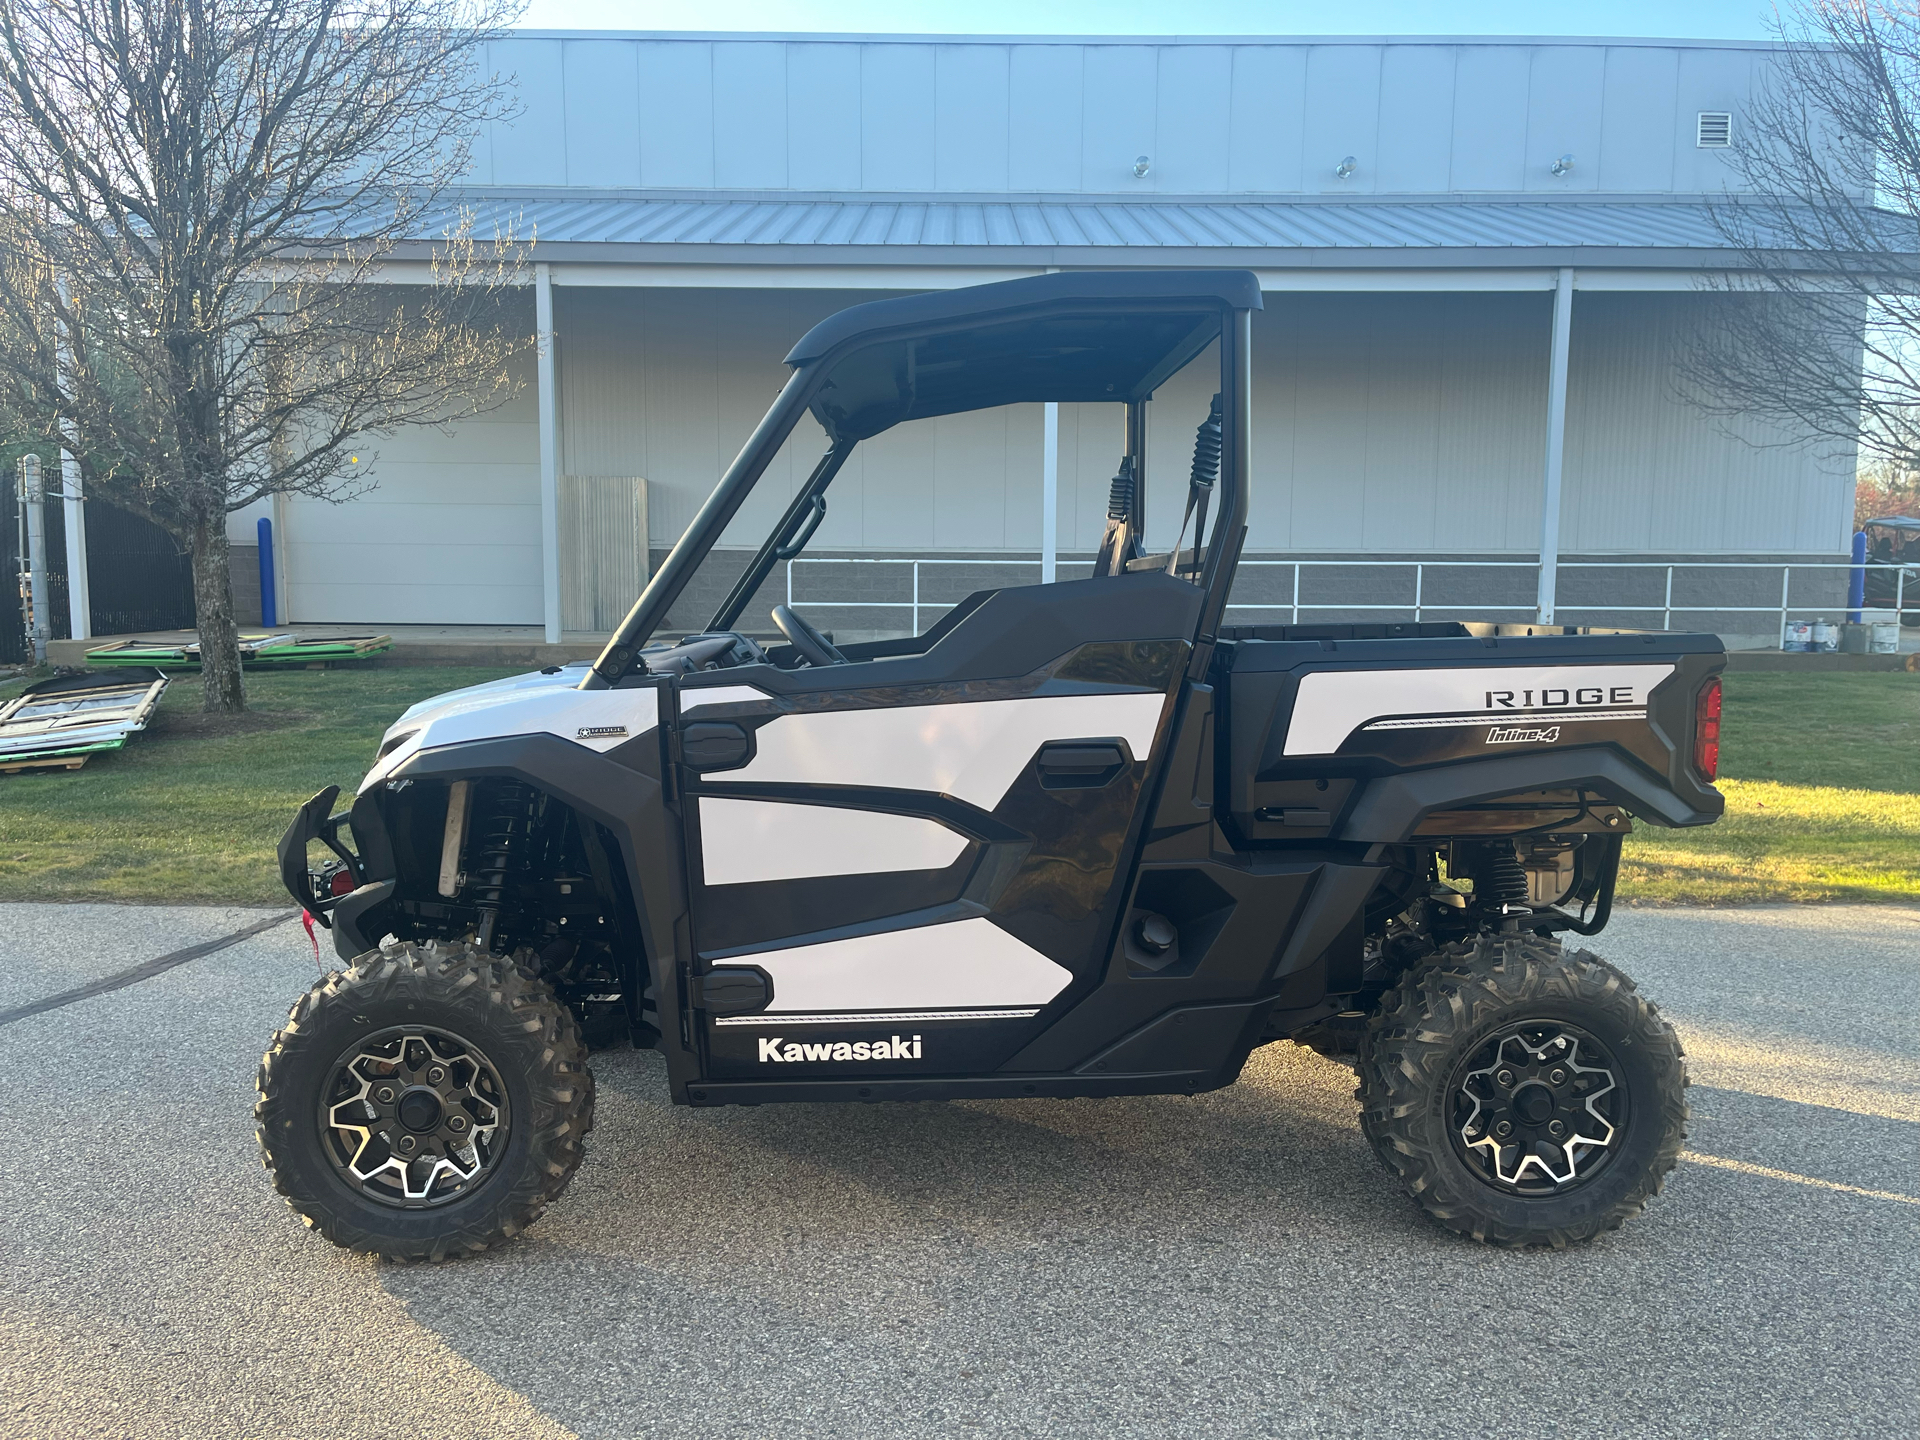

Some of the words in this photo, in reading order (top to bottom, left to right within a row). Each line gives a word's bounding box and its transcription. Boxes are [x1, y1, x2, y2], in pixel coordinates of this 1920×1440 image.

[1485, 687, 1633, 708] RIDGE
[1485, 726, 1560, 744] Inline-4
[758, 1034, 922, 1063] Kawasaki
